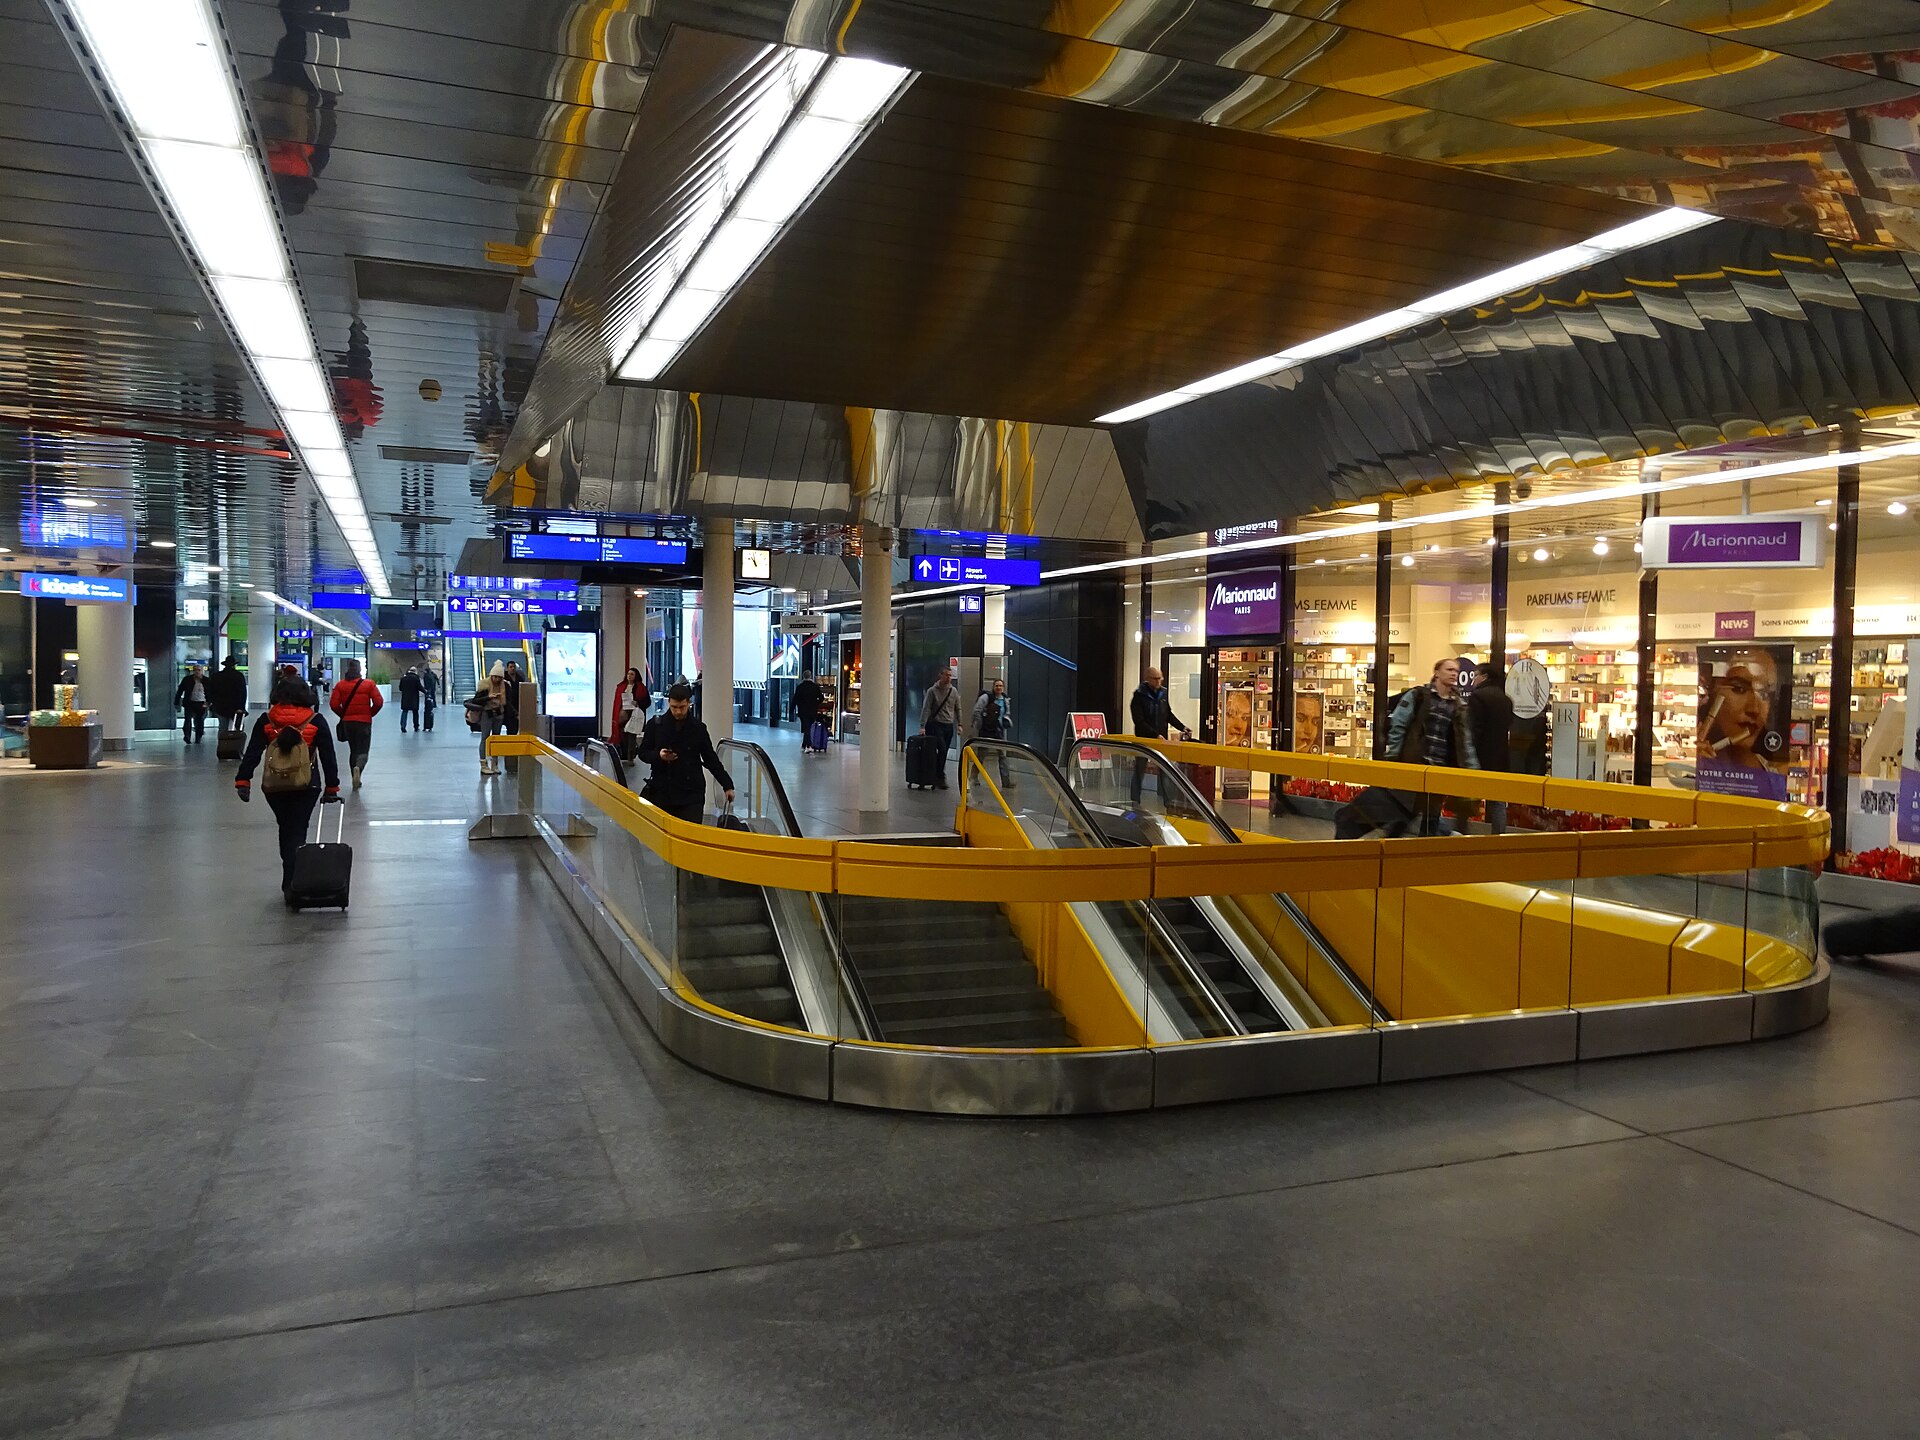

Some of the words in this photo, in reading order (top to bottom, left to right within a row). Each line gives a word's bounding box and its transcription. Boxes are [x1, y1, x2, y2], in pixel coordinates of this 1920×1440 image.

[1681, 530, 1787, 551] Marionnaud
[42, 578, 91, 596] kiosk
[1210, 582, 1277, 610] Marionnaud
[1526, 592, 1574, 606] PARFUMS
[1577, 590, 1616, 603] FEMME
[1235, 606, 1251, 615] PARIS
[1315, 600, 1358, 611] FEMME
[1571, 625, 1612, 633] BVLGARI
[1720, 619, 1749, 630] NEWS
[1521, 661, 1533, 673] HR
[1557, 708, 1573, 723] HR
[1699, 769, 1723, 778] VOTRE
[1725, 771, 1754, 780] CADEAU
